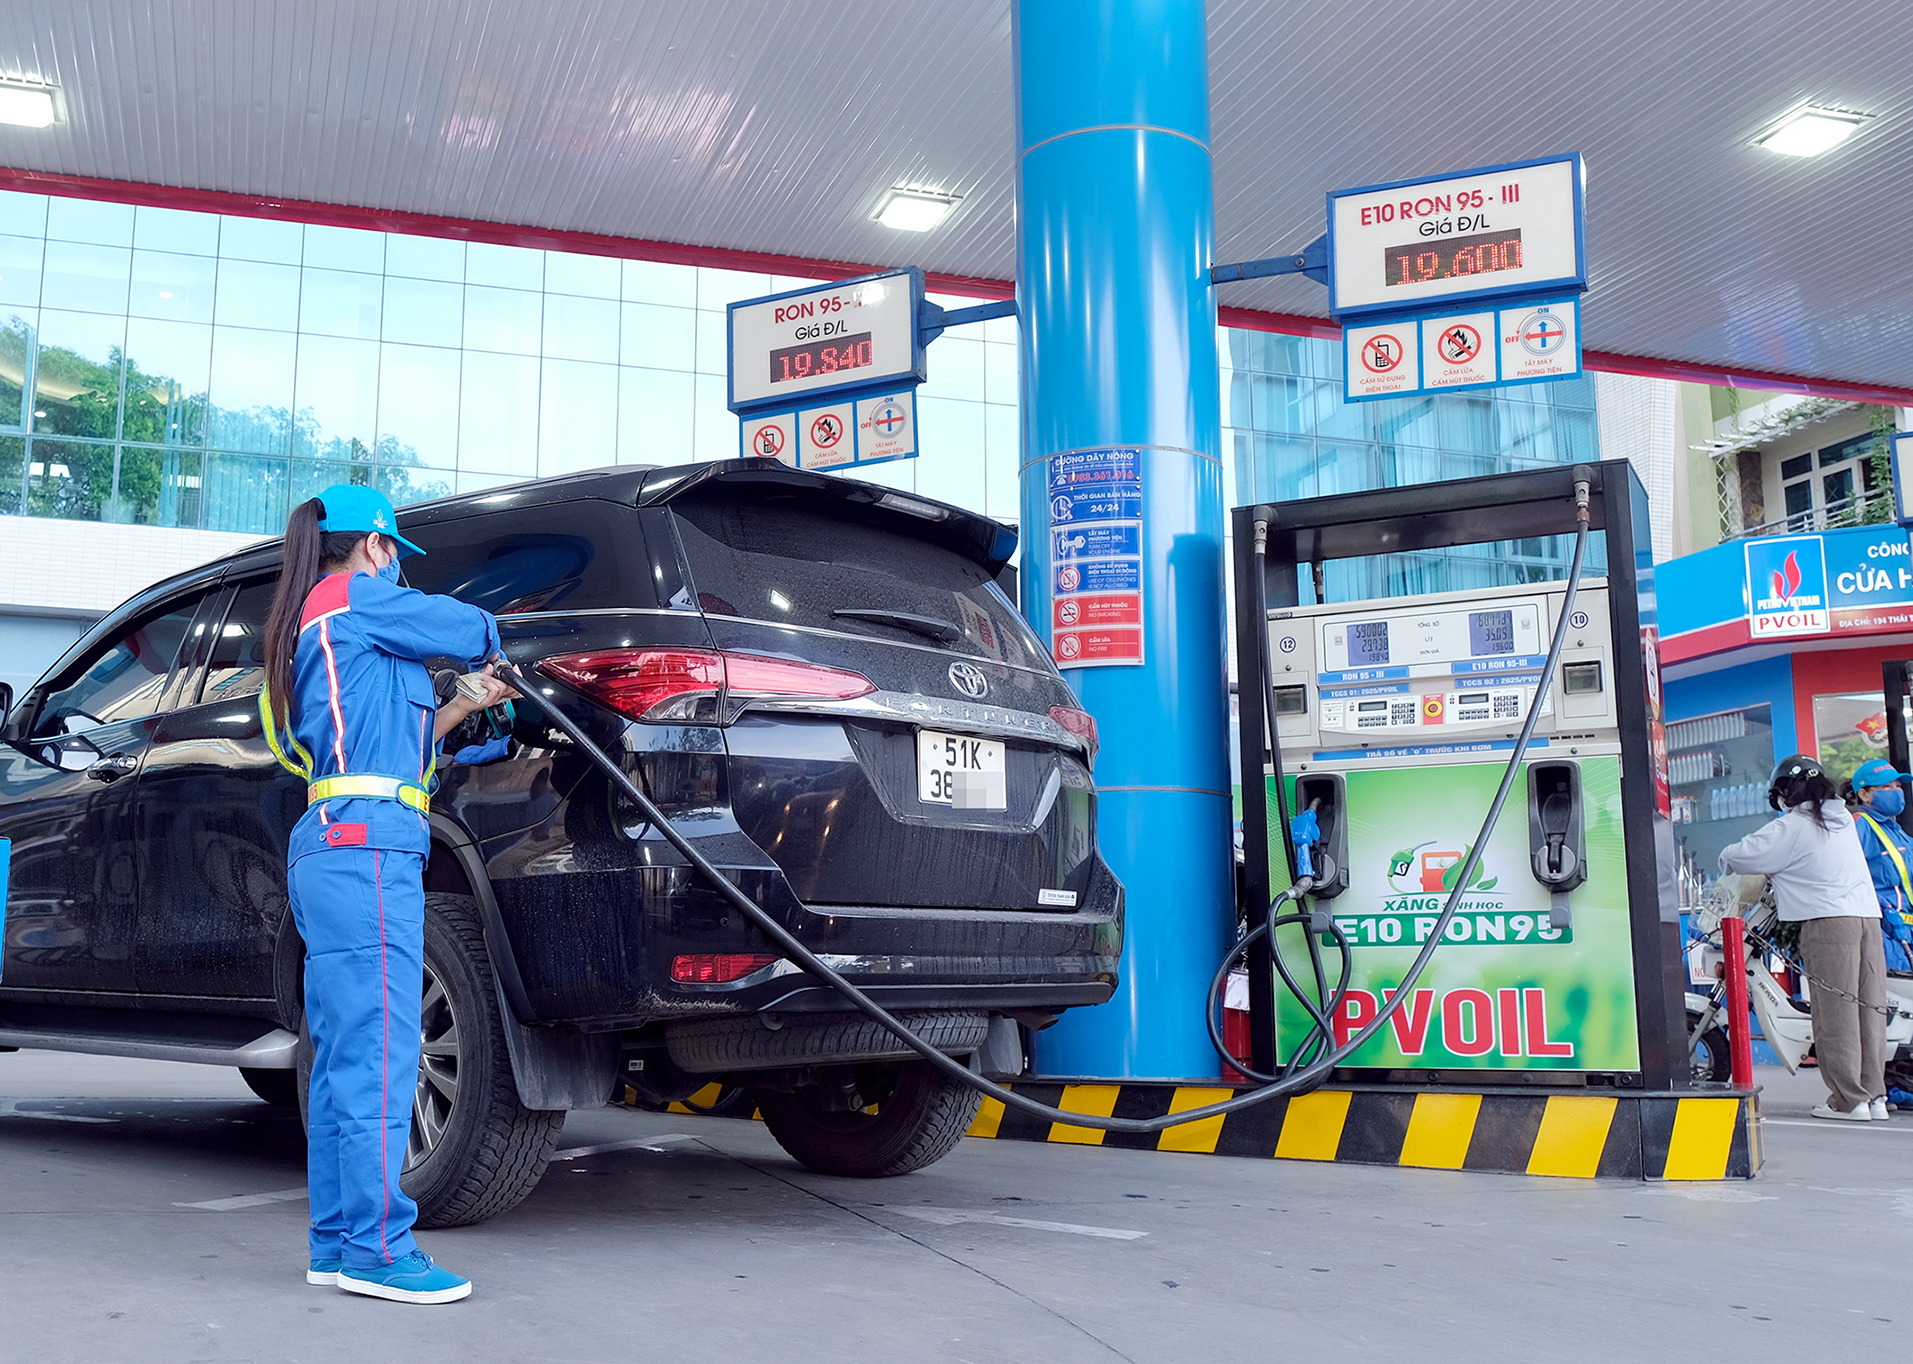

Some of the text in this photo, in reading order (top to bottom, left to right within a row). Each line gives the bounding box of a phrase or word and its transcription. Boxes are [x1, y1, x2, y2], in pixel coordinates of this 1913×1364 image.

[1361, 204, 1395, 226] E10
[1400, 194, 1452, 219] RON
[1456, 189, 1483, 210] 95
[1418, 213, 1490, 237] Giá Đ/L
[1396, 239, 1522, 286] 19.600
[774, 301, 814, 324] RON
[1537, 307, 1550, 315] ON
[795, 320, 848, 340] Giá Đ/L
[1505, 336, 1520, 344] OFF
[779, 340, 873, 383] 19.840
[1538, 358, 1554, 366] MÁY
[1443, 366, 1474, 377] CẤM LỬA
[1517, 366, 1563, 377] PHƯƠNG TIỆN
[1360, 374, 1406, 385] CẤM SỬ DỤNG
[1432, 374, 1485, 387] CẤM HÚT THUỐC
[1365, 384, 1401, 394] ĐIỆN THOẠI
[861, 422, 873, 430] OFF
[885, 440, 897, 448] MÁY
[815, 449, 838, 459] CẤM LỬA
[870, 447, 904, 458] PHƯƠNG TIỆN
[1087, 453, 1105, 461] DÂY
[1107, 451, 1134, 460] NÓNG
[806, 456, 847, 468] CẤM HÚT THUỐC
[1073, 493, 1088, 501] THỜI
[1122, 490, 1141, 498] HÀNG
[1090, 503, 1120, 513] 24/24
[1837, 563, 1893, 594] CỬA
[1757, 595, 1820, 610] PETROVIETNAM
[1573, 615, 1585, 625] 10
[1759, 614, 1821, 630] PVOIL
[1839, 619, 1853, 628] ĐỊA
[1888, 614, 1908, 624] THÁI
[1282, 640, 1293, 649] 12
[1472, 661, 1486, 671] E10
[1488, 660, 1505, 669] RON
[1342, 672, 1358, 681] RON
[1360, 671, 1370, 680] 95
[1462, 679, 1482, 687] TCCS
[1484, 678, 1494, 686] 02
[1361, 686, 1398, 695] 2025/PVOIL
[945, 738, 981, 770] 51K
[1366, 749, 1382, 758] TRẢ
[1384, 748, 1396, 757] SỐ
[1397, 747, 1408, 756] VỀ
[1425, 746, 1453, 754] TRƯỚC
[1472, 743, 1492, 751] BƠM
[1382, 896, 1504, 912] XĂNG SNH HỌC
[1334, 918, 1402, 943] E10
[1758, 982, 1779, 1007] HONDA
[1330, 988, 1574, 1057] PVOIL
